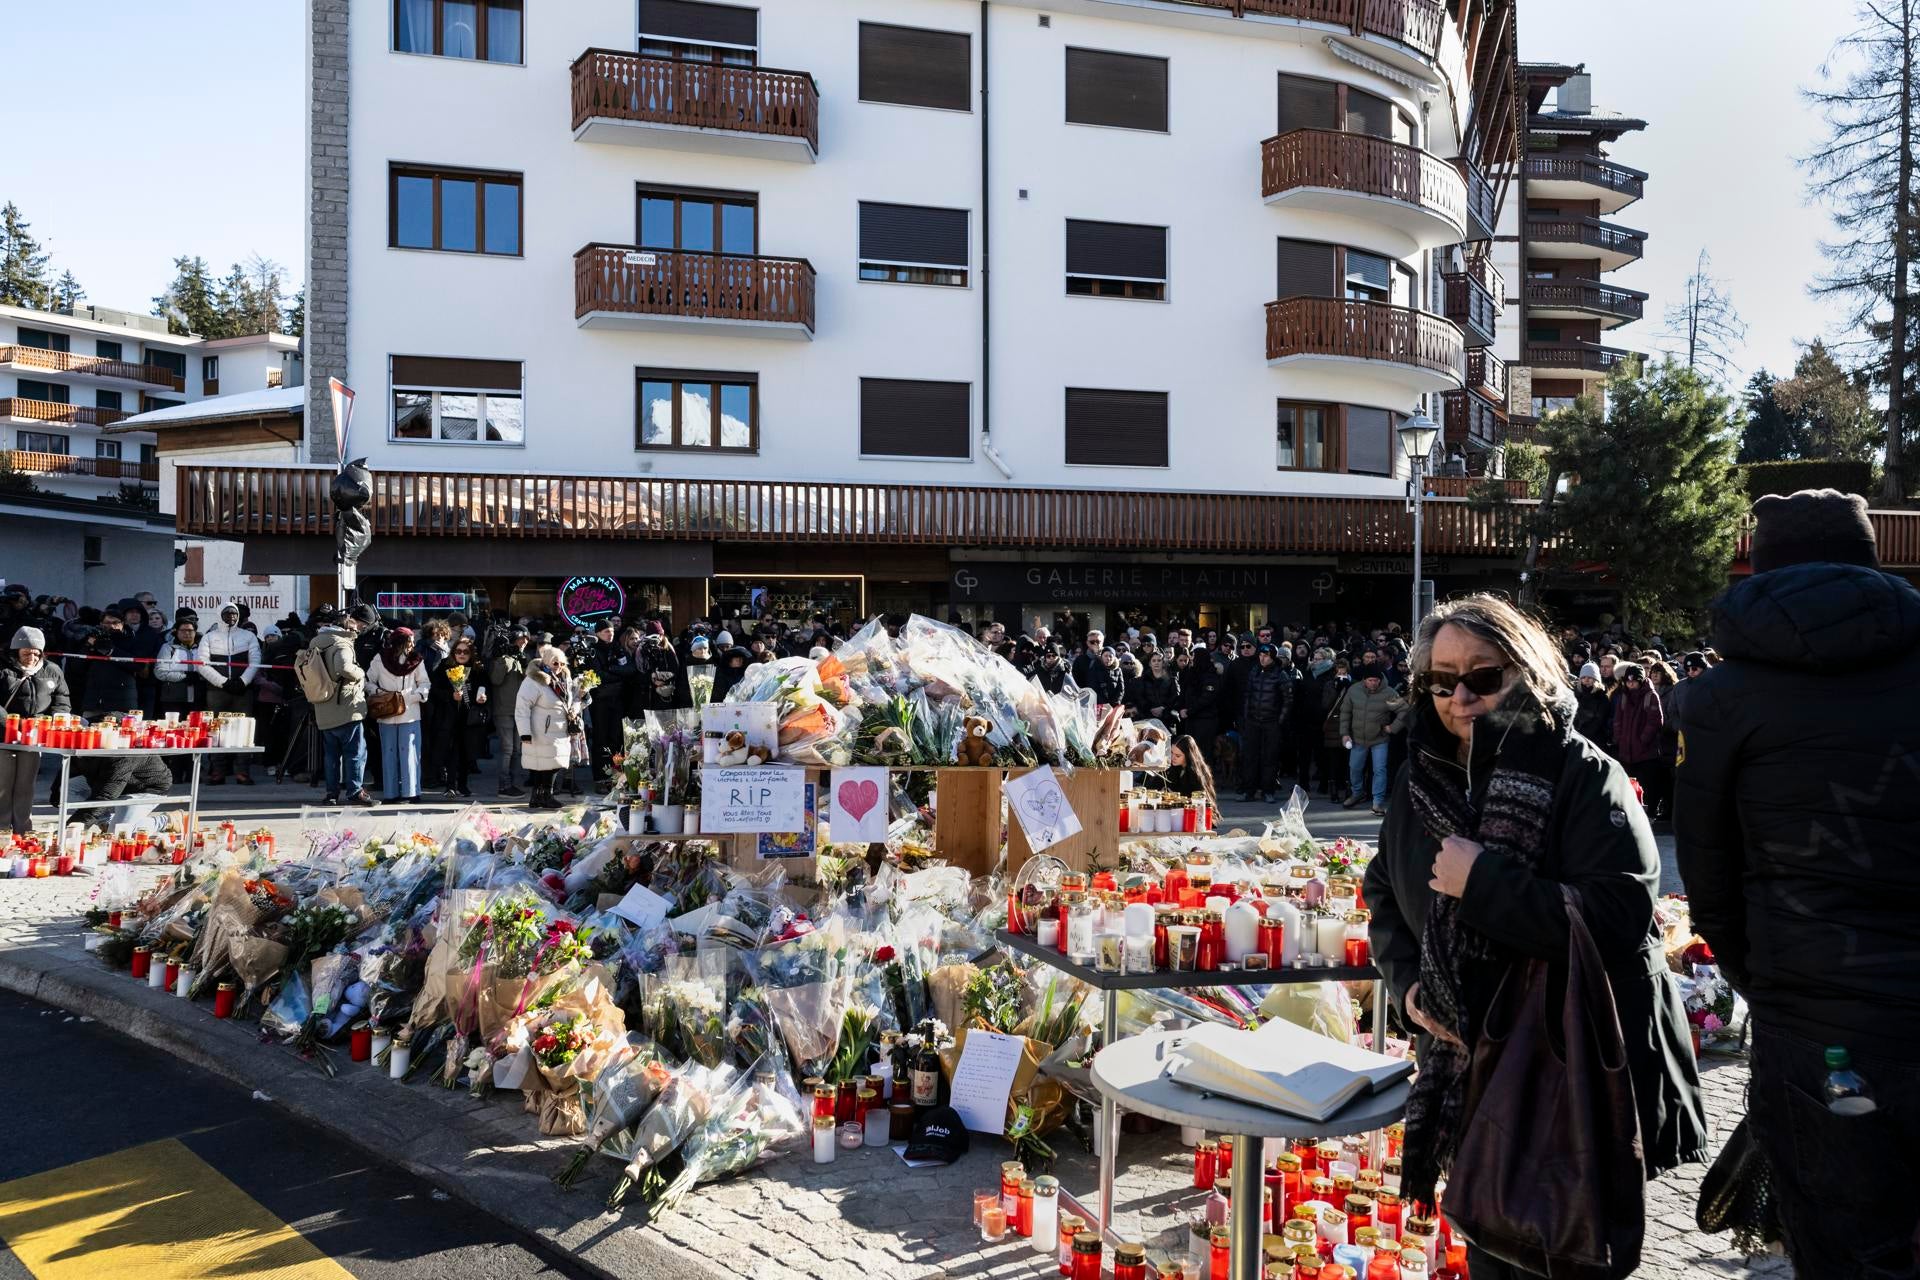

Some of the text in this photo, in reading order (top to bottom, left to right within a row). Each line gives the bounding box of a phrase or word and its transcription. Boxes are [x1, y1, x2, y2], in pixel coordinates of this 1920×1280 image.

[569, 576, 588, 591] MAX
[596, 576, 616, 592] MAX
[1026, 567, 1269, 586] GALERIE PLATINI
[575, 585, 605, 601] Tiny
[177, 595, 222, 609] PENSION
[567, 598, 618, 615] Diner
